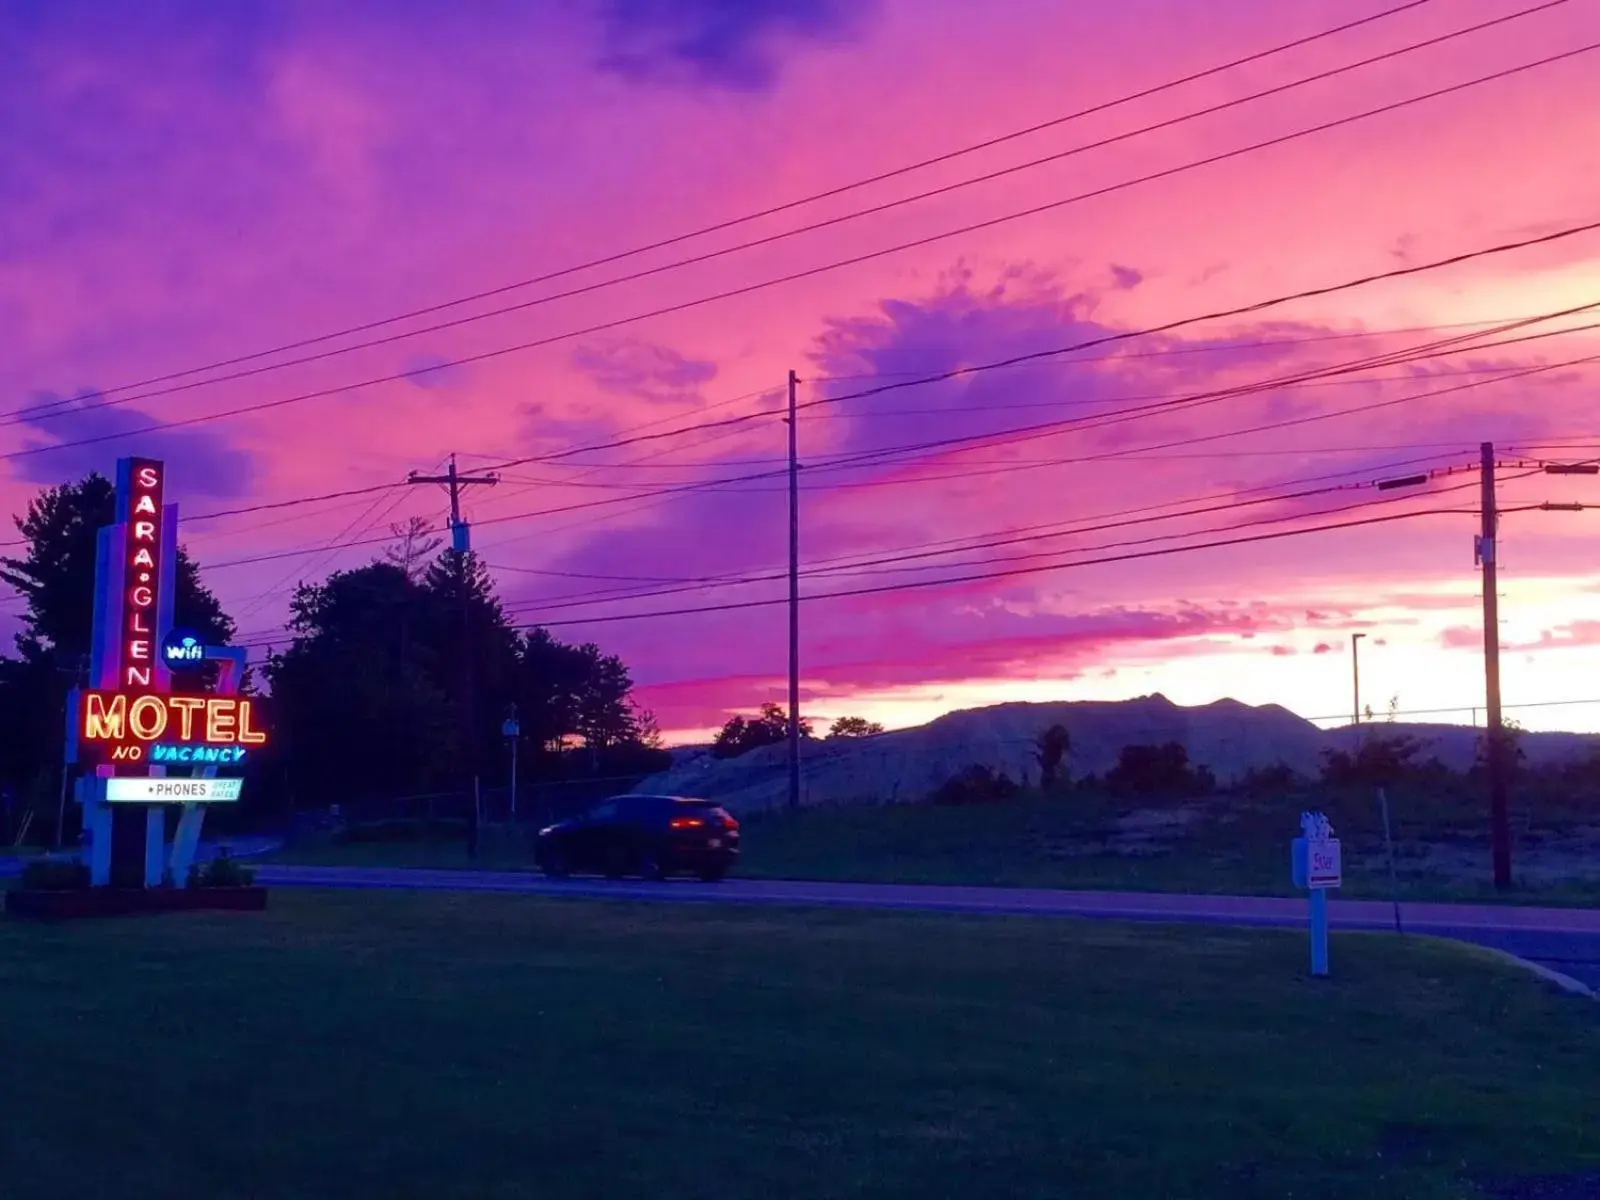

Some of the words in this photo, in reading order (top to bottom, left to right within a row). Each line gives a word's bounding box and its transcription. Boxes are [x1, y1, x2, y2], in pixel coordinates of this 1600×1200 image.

[86, 694, 266, 743] MOTEL
[111, 746, 142, 760] NO
[152, 745, 246, 762] VACANCY
